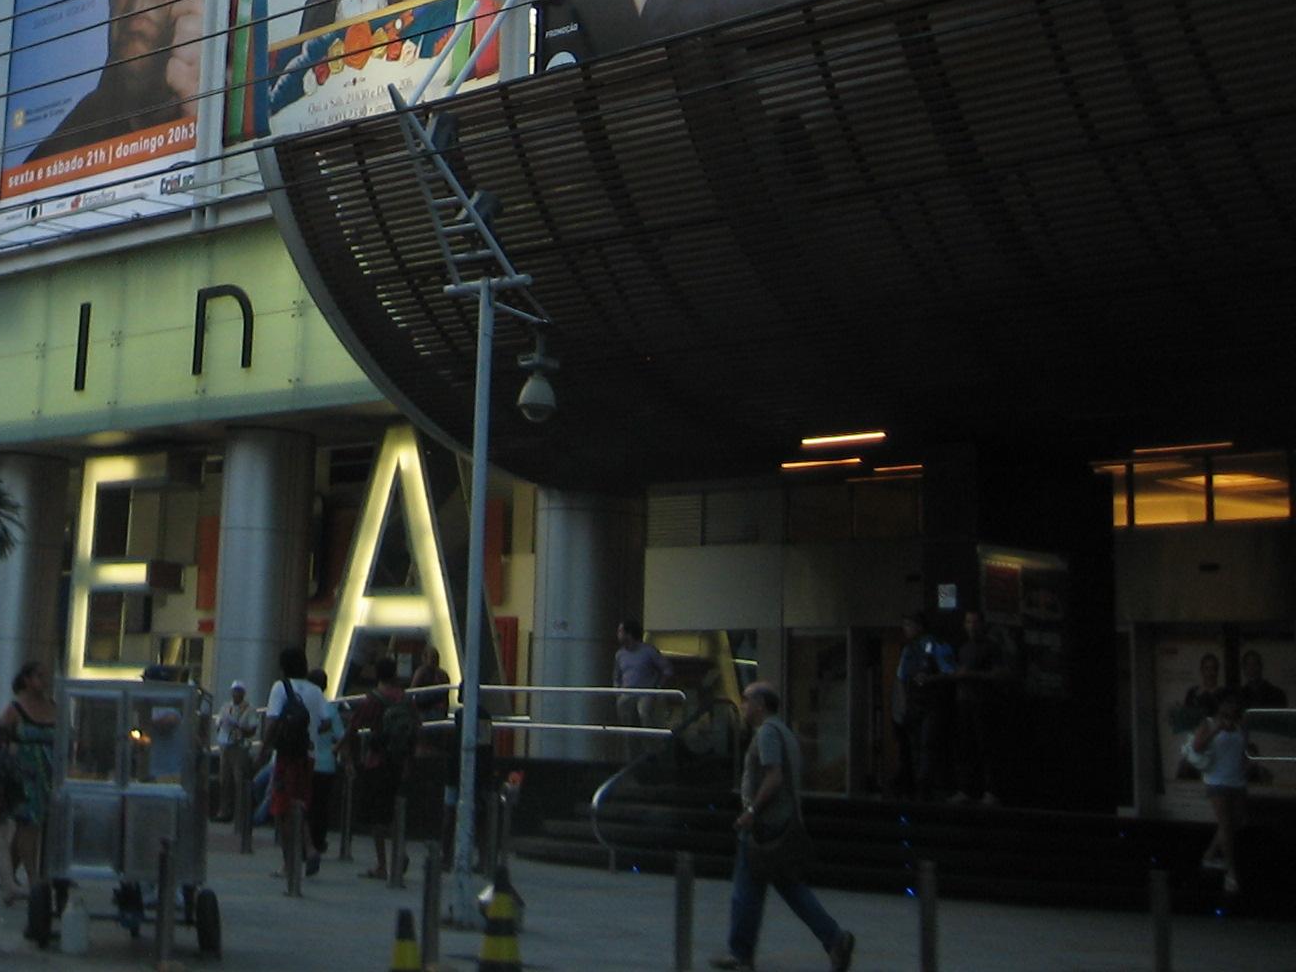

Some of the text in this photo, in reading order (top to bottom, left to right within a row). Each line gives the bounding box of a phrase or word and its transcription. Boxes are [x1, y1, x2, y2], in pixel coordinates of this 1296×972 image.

[8, 169, 35, 189] sexta
[36, 167, 43, 180] e
[45, 155, 84, 176] sábado
[86, 147, 106, 167] 21h
[115, 134, 165, 154] domingo
